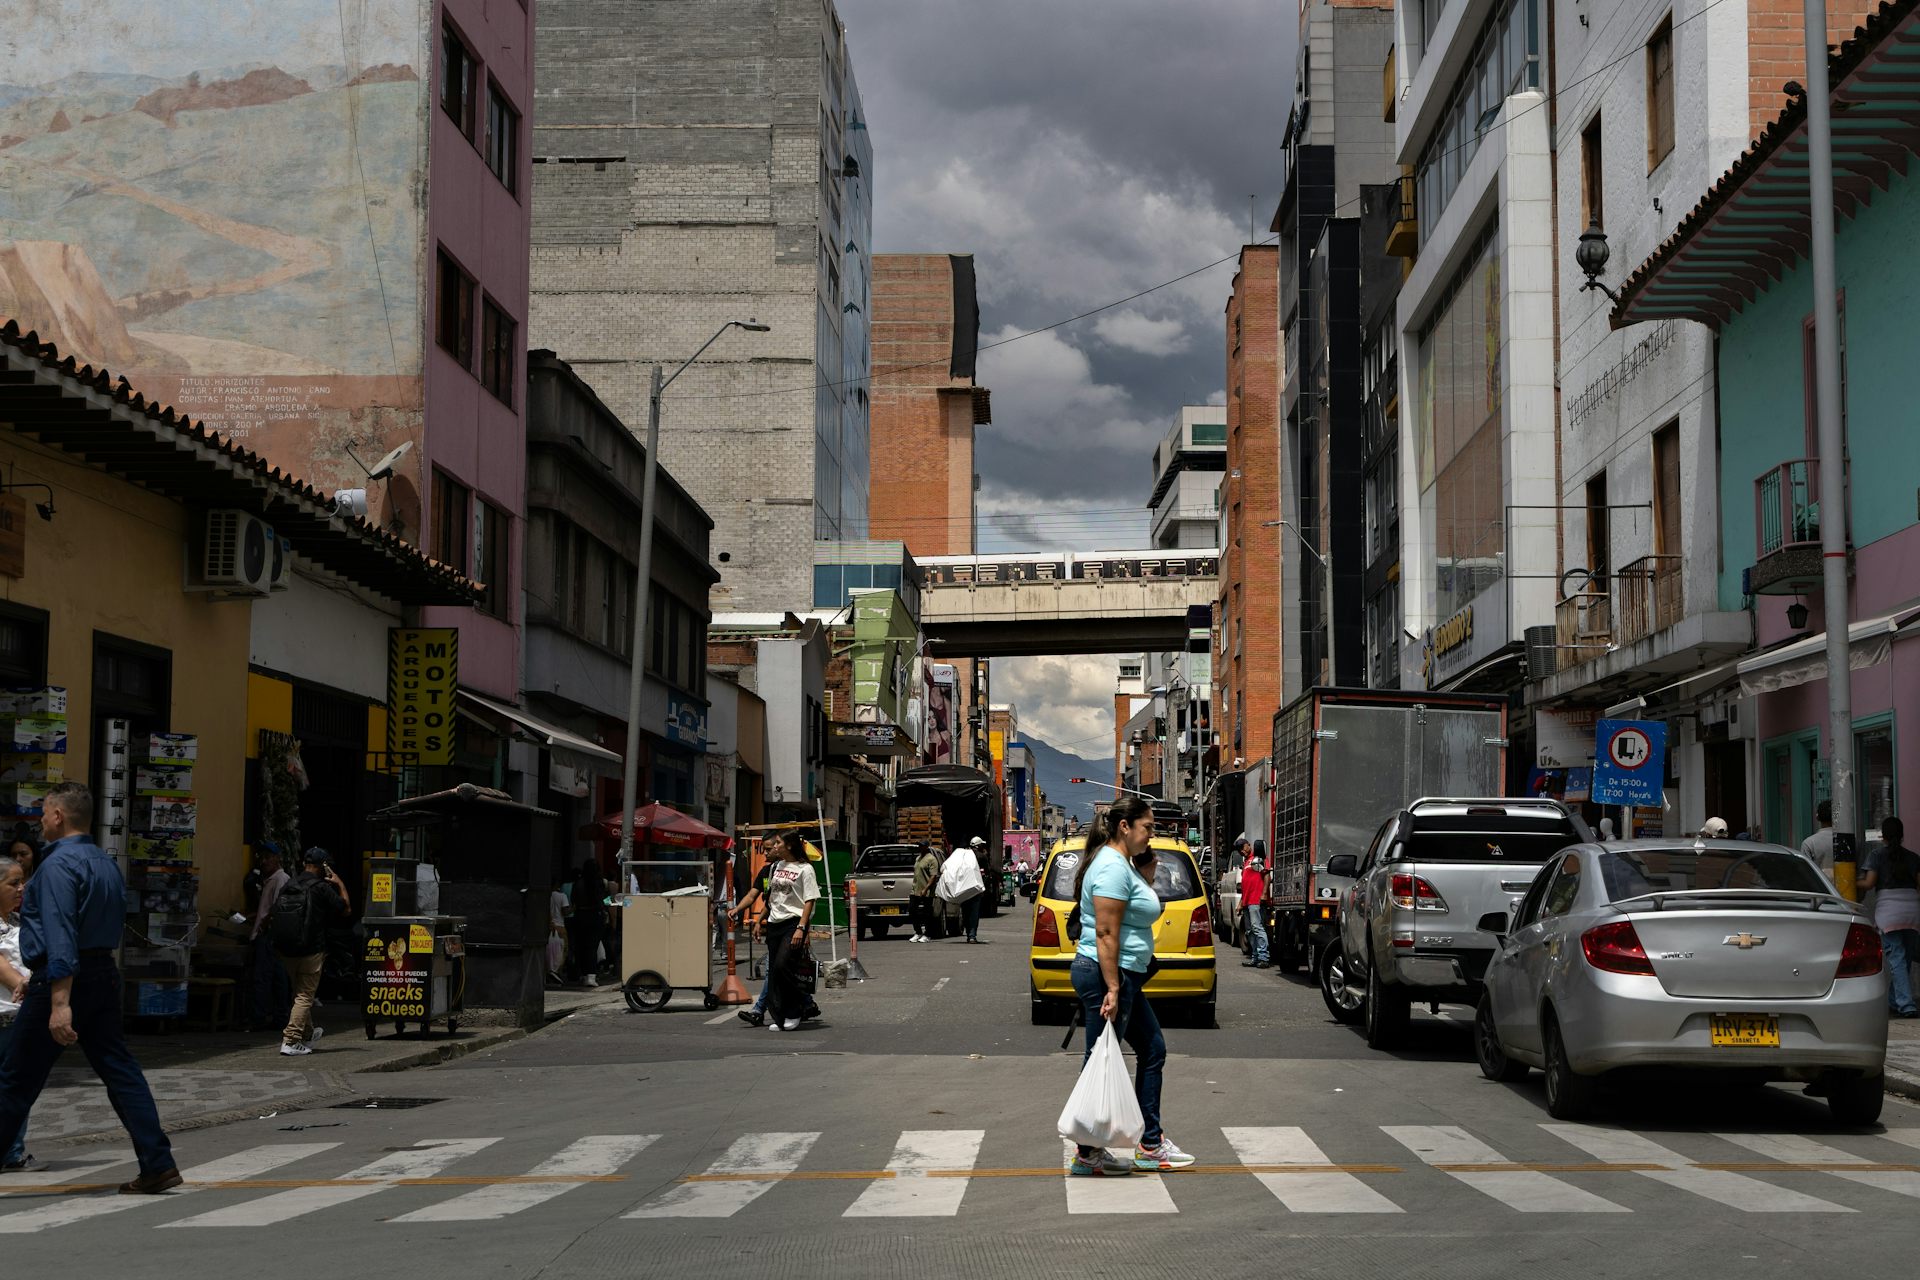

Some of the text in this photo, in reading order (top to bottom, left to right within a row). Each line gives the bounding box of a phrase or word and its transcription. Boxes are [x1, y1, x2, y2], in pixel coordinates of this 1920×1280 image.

[215, 378, 265, 386] HORIZONTES
[267, 386, 301, 394] ANTONIO
[269, 412, 300, 420] URBANA
[402, 633, 420, 761] PARQUEADERO
[424, 643, 446, 751] MOTOS
[1608, 777, 1618, 786] De
[1621, 778, 1641, 787] 15:00
[1603, 789, 1624, 797] 17:00
[370, 984, 424, 1001] snacks
[367, 1001, 425, 1017] de Queso
